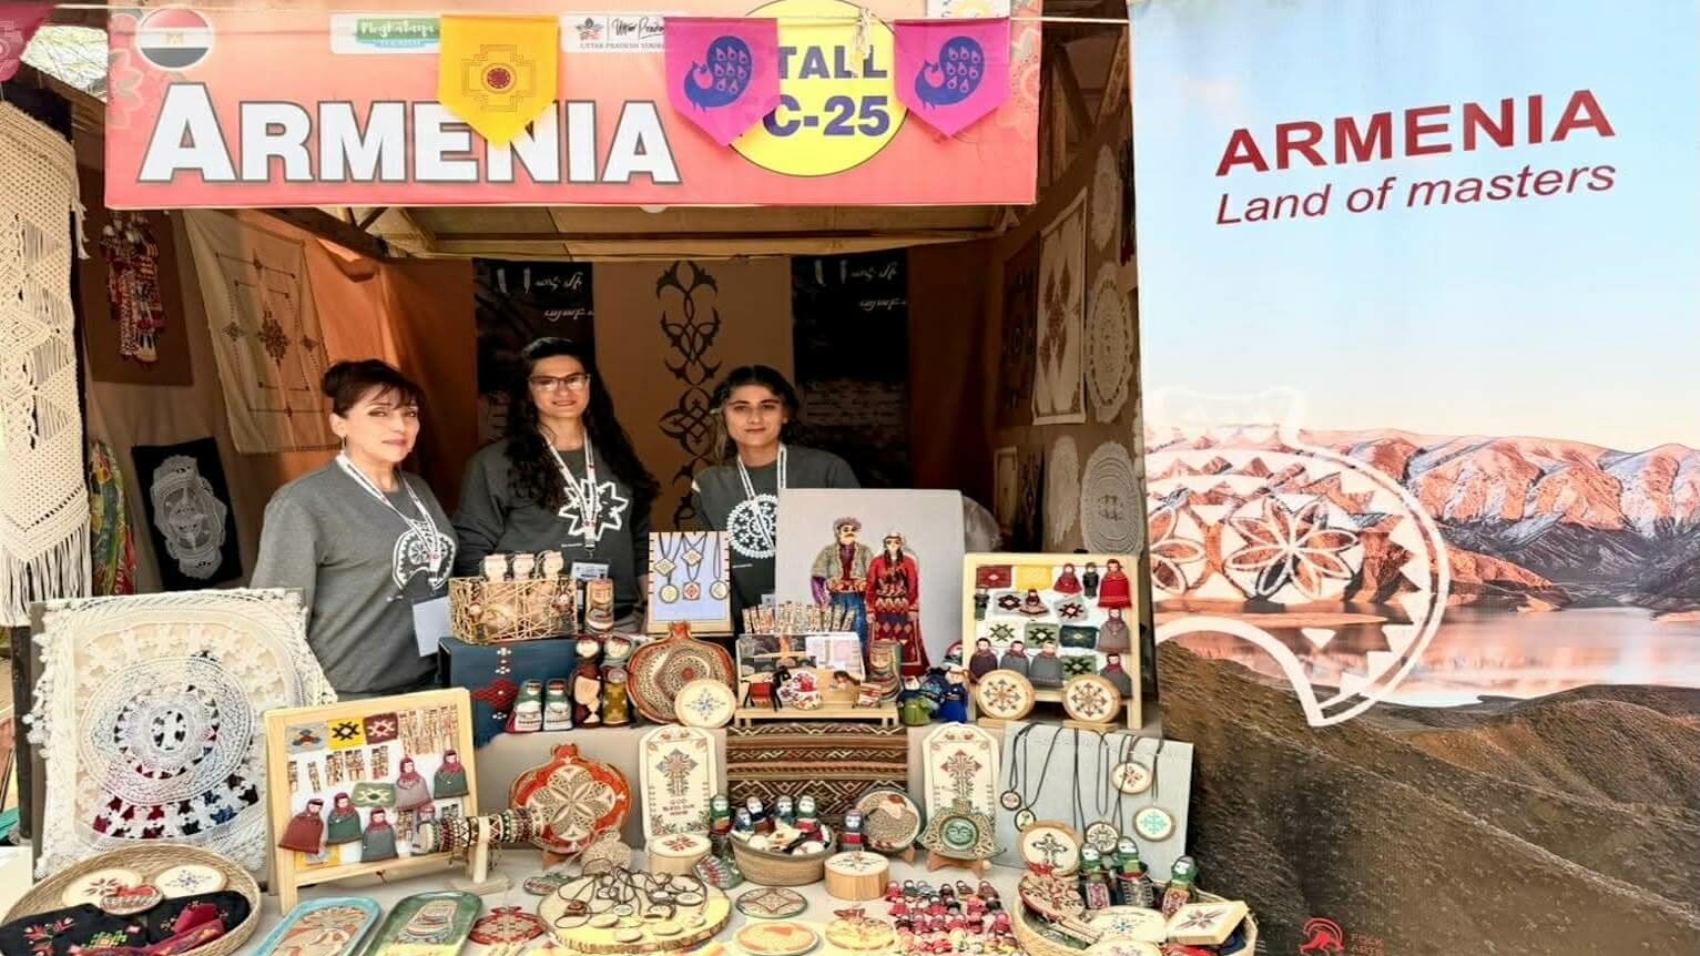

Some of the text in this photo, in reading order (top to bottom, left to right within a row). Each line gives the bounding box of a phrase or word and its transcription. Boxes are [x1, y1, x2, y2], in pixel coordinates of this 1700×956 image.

[778, 45, 888, 79] TALL
[136, 82, 682, 184] ARMENIA
[762, 94, 890, 137] C-25
[1215, 89, 1616, 176] ARMENIA
[1216, 164, 1617, 224] Land of masters
